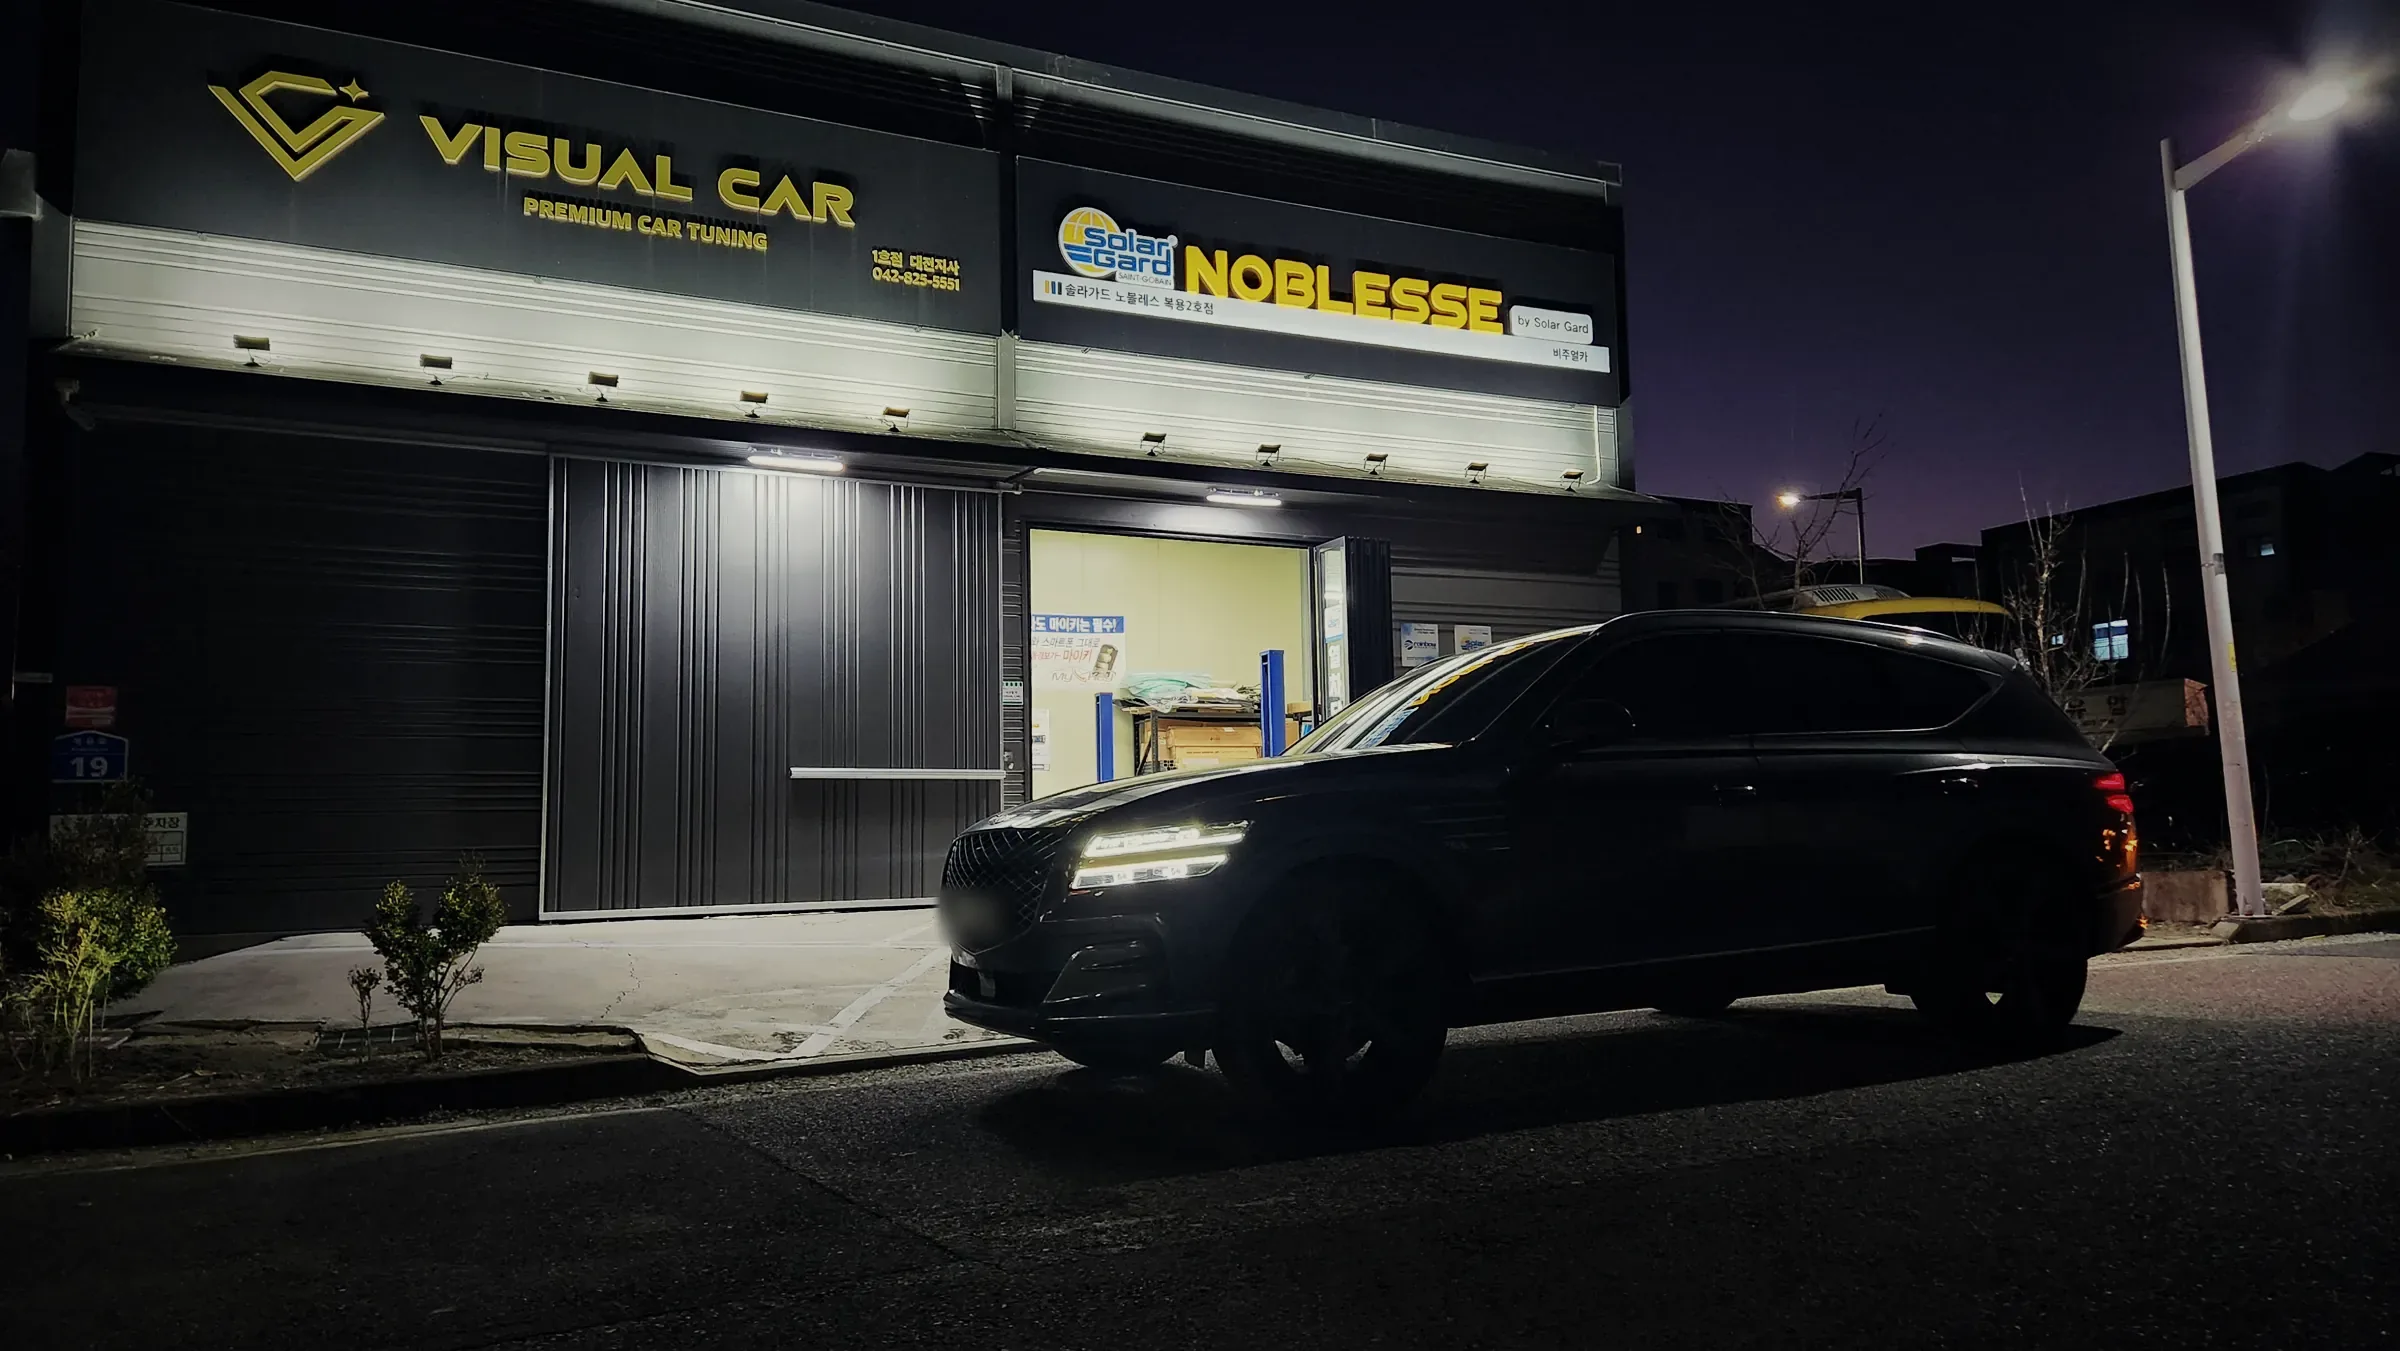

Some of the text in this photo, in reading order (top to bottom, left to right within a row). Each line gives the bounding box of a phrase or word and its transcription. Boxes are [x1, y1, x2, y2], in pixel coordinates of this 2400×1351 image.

[419, 115, 856, 228] VISUAL CAR
[523, 196, 768, 250] PREMIUM CAR TUNING
[1084, 227, 1170, 257] Solar
[872, 249, 960, 276] 1호점 대전지사
[1093, 248, 1172, 277] Gard
[872, 266, 960, 291] 042-825-5551
[1185, 245, 1504, 335] NOBLESSE
[1065, 283, 1111, 300] 솔라가드
[1164, 298, 1214, 316] 복용2호점
[1517, 315, 1589, 334] by Solar Gard
[1552, 348, 1588, 362] 비주얼카
[1049, 616, 1090, 632] 마이키는
[69, 755, 108, 778] 19
